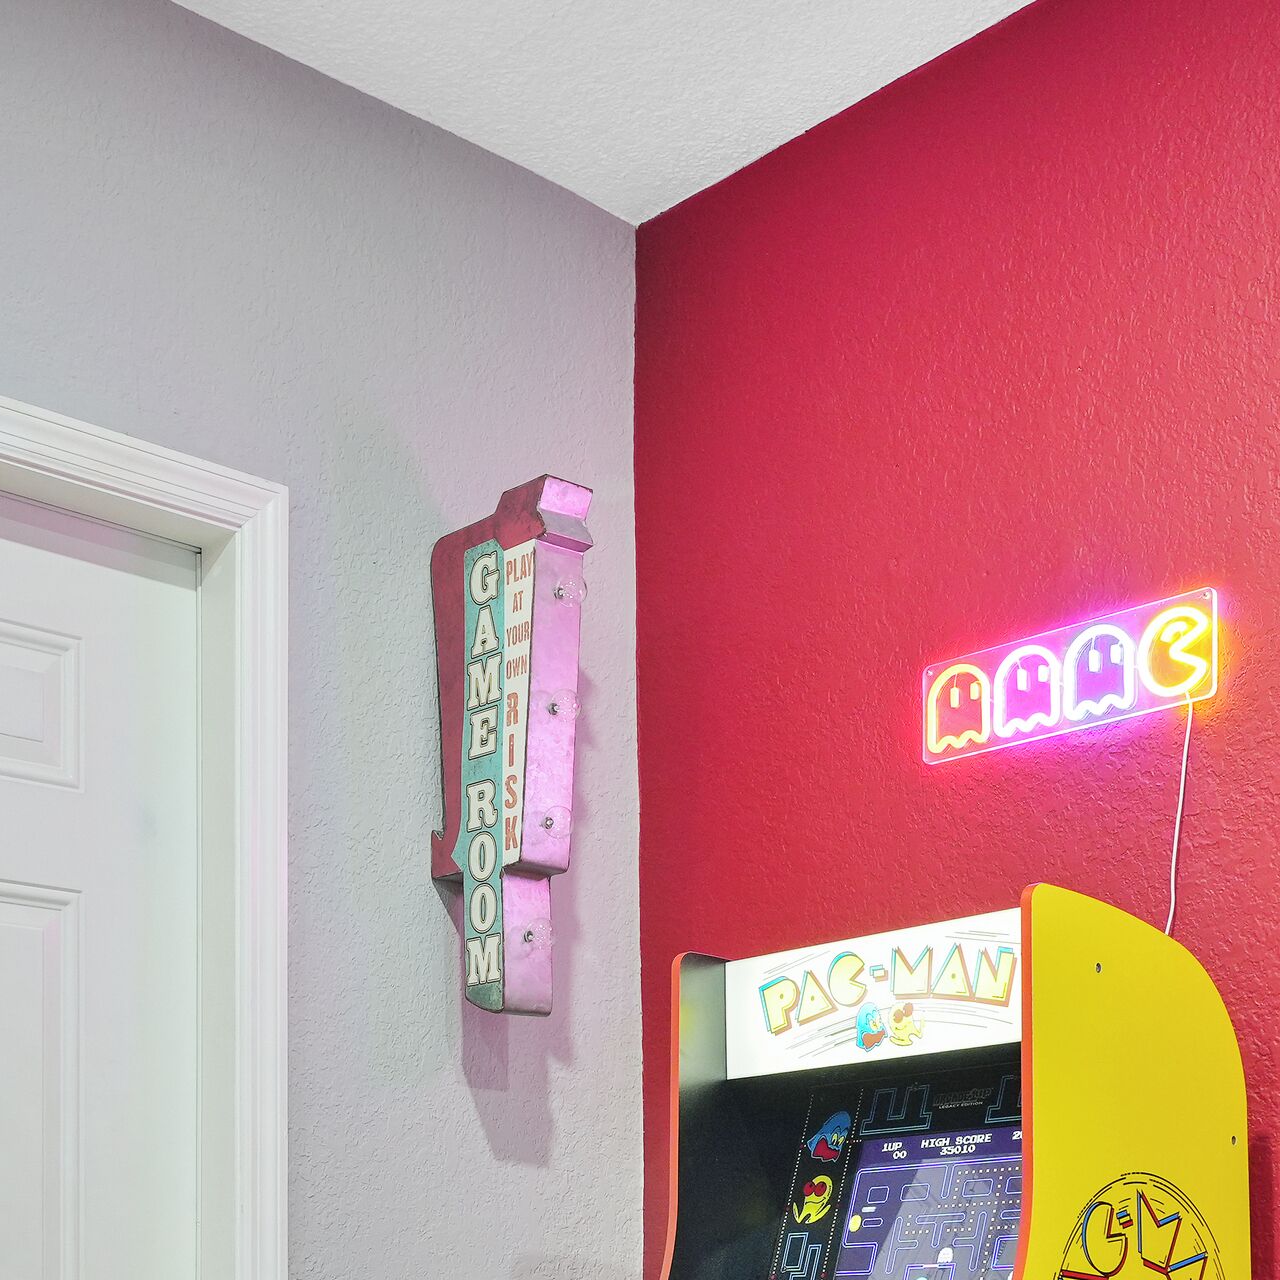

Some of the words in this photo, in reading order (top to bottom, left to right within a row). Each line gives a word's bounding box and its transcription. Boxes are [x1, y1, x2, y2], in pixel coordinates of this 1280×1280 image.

[506, 551, 534, 585] PLAY
[512, 590, 524, 613] AT
[506, 620, 530, 647] YOUR
[466, 550, 502, 760] GAME
[506, 654, 528, 680] OWN
[505, 692, 520, 852] RISK
[465, 778, 502, 987] ROOM
[758, 943, 1018, 1035] PAC-MAN
[881, 1141, 903, 1152] 1UP
[920, 1137, 951, 1149] HIGH
[955, 1133, 993, 1145] SCORE
[939, 1144, 976, 1156] 35010
[892, 1150, 908, 1160] 00
